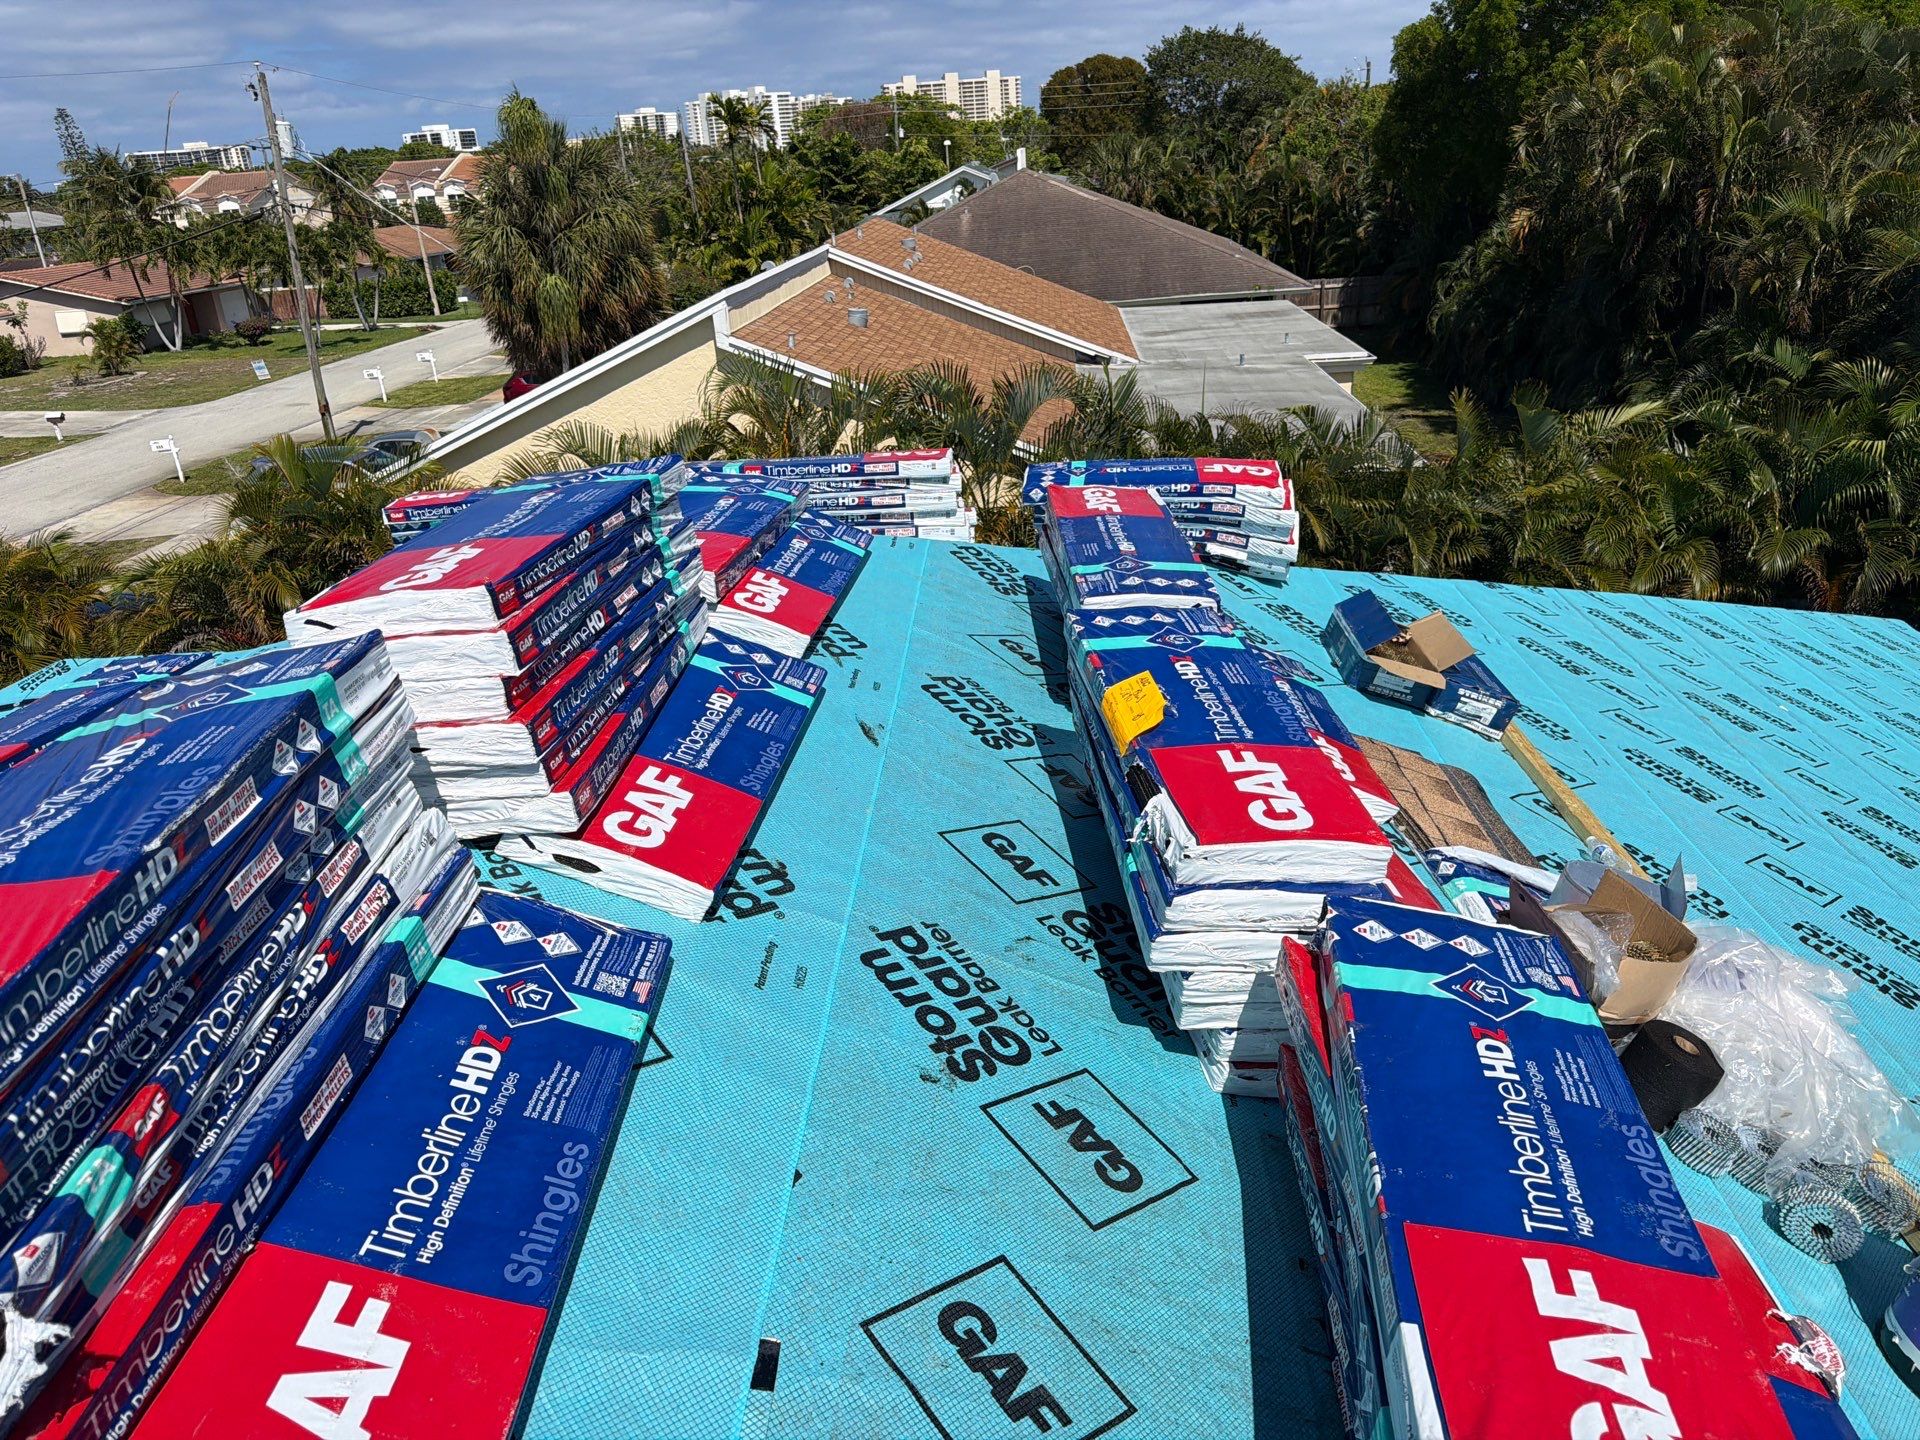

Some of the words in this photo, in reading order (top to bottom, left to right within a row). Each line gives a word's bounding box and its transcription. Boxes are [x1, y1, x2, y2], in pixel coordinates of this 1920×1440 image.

[1081, 488, 1123, 513] GAF
[499, 588, 515, 604] GAF
[734, 571, 789, 613] GAF
[519, 634, 533, 652] GAF
[537, 719, 552, 739] GAF
[920, 683, 1015, 751] Storm
[550, 753, 565, 771] GAF
[740, 741, 785, 791] Shingles
[207, 815, 218, 828] DO
[218, 803, 231, 819] NOT
[231, 778, 254, 806] TRIPLE
[579, 787, 592, 805] GAF
[603, 765, 694, 849] GAF
[1216, 749, 1315, 831] GAF
[211, 813, 231, 841] STACK
[231, 793, 257, 823] PALLETS
[229, 884, 240, 896] DO
[253, 842, 276, 869] TRIPLE
[233, 881, 253, 907] STACK
[253, 852, 280, 885] PALLETS
[319, 871, 329, 885] DO
[329, 859, 340, 874] NOT
[325, 873, 341, 894] STACK
[981, 831, 1060, 888] GAF
[1763, 862, 1828, 898] GAF
[0, 834, 187, 1044] imberlineHDZ
[124, 902, 167, 945] Shingles
[240, 905, 271, 940] PALLETS
[349, 921, 367, 942] STACK
[1034, 914, 1097, 963] Leak
[754, 967, 769, 991] Patent
[761, 941, 779, 972] Pending
[921, 921, 1001, 992] Barrier
[286, 996, 318, 1035] Shingles
[860, 946, 997, 1083] Storm
[998, 997, 1063, 1057] Leak
[23, 1121, 54, 1154] High
[150, 976, 187, 1015] Shingles
[553, 1077, 566, 1097] Nailing
[562, 1065, 572, 1079] Area
[564, 1070, 581, 1097] Technology
[1527, 1059, 1551, 1102] Shingles
[302, 1111, 313, 1126] DO
[313, 1090, 326, 1110] NOT
[326, 1056, 347, 1089] TRIPLE
[306, 1106, 326, 1135] STACK
[325, 1066, 351, 1106] PALLETS
[539, 1089, 551, 1107] Algae
[134, 1093, 166, 1141] GAF
[416, 1232, 445, 1264] High
[495, 1071, 520, 1117] Shingles
[1032, 1099, 1144, 1194] GAF
[135, 1158, 174, 1210] GAF
[1621, 1124, 1700, 1262] Shingles
[503, 1142, 589, 1287] Shingles
[1568, 1209, 1595, 1238] High
[84, 1141, 287, 1437] TimberlineHDZ
[132, 1338, 185, 1410] Definition
[222, 1222, 259, 1280] Shingles
[265, 1280, 412, 1440] AF
[937, 1300, 1073, 1434] GAF
